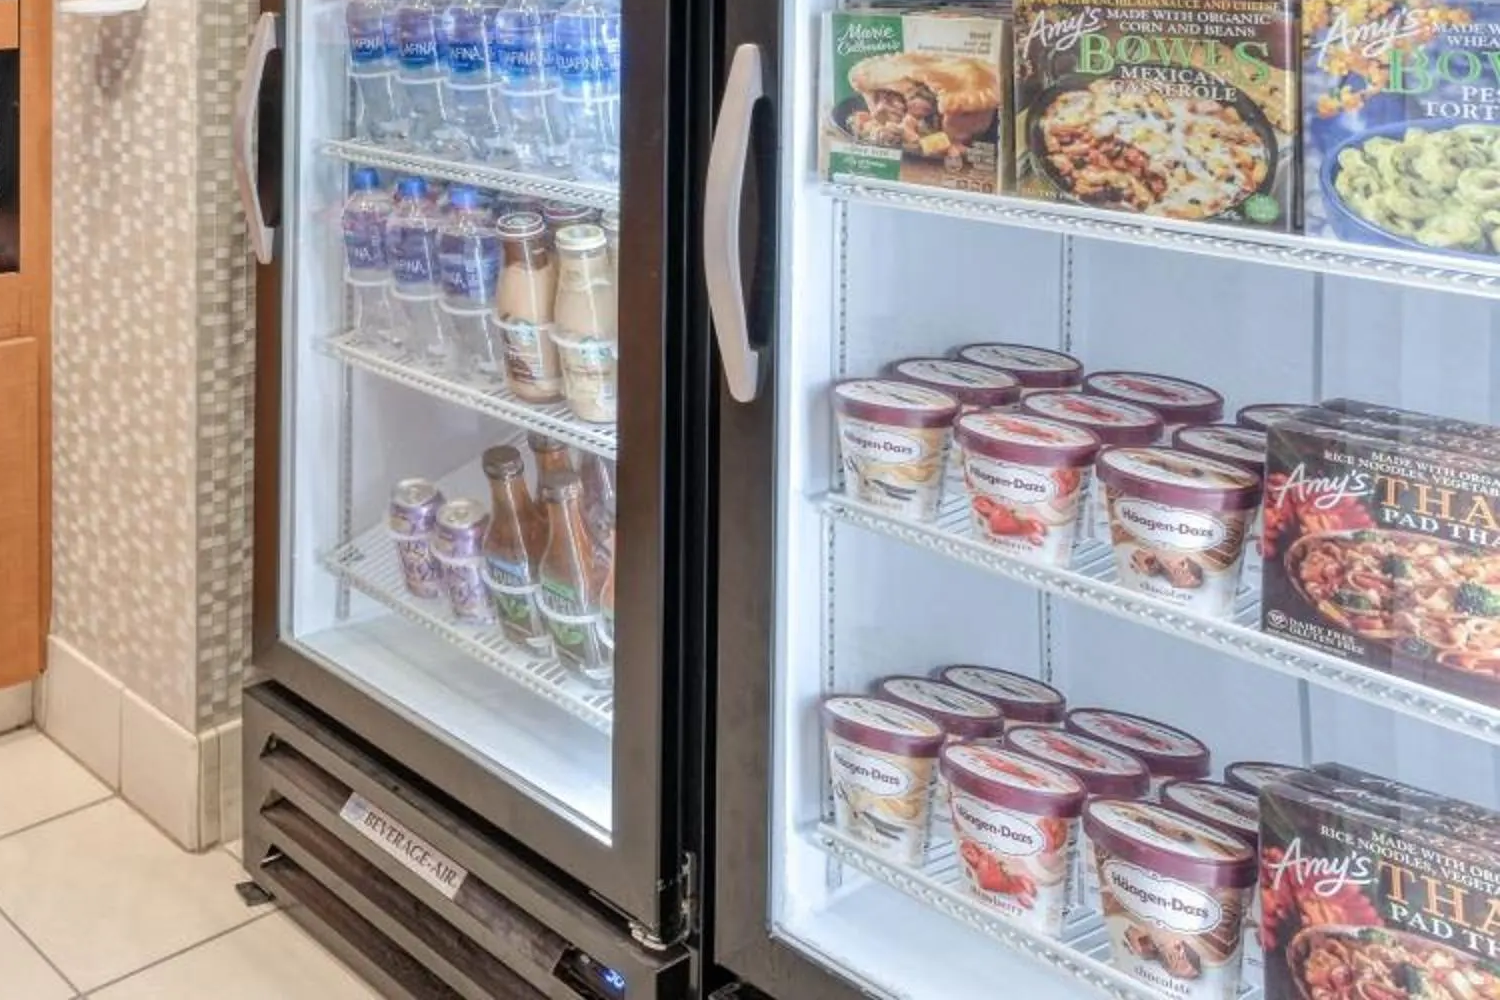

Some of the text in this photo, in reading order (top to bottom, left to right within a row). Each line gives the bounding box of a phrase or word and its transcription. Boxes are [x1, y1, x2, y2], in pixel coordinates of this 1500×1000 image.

[1020, 6, 1102, 60] Amy's
[1107, 7, 1272, 25] MADE WITH ORGANIC
[1119, 20, 1257, 38] CORN AND BEANS
[1433, 22, 1486, 36] MADE
[1075, 32, 1270, 86] BOWLS
[1310, 6, 1428, 70] Amy's
[1446, 34, 1500, 48] WHEA
[1110, 80, 1238, 101] CASSEROLE
[1119, 65, 1228, 86] MEXICAN
[1462, 85, 1500, 104] PES
[1276, 464, 1373, 510] Amy's
[1323, 450, 1355, 465] RICE
[1430, 474, 1500, 497] VEGETAB
[1371, 451, 1500, 488] MADE WITH ORGA
[1374, 472, 1500, 534] THA
[1380, 507, 1500, 549] PAD THA
[363, 810, 458, 889] BEVERAGE-AIR
[1265, 837, 1374, 896] Amy's
[1320, 824, 1354, 846] RICE
[1441, 866, 1500, 895] VEGETA
[1371, 830, 1417, 855] MADE
[1420, 847, 1466, 873] WITH
[1377, 859, 1500, 936] THA
[1389, 902, 1454, 940] PAD
